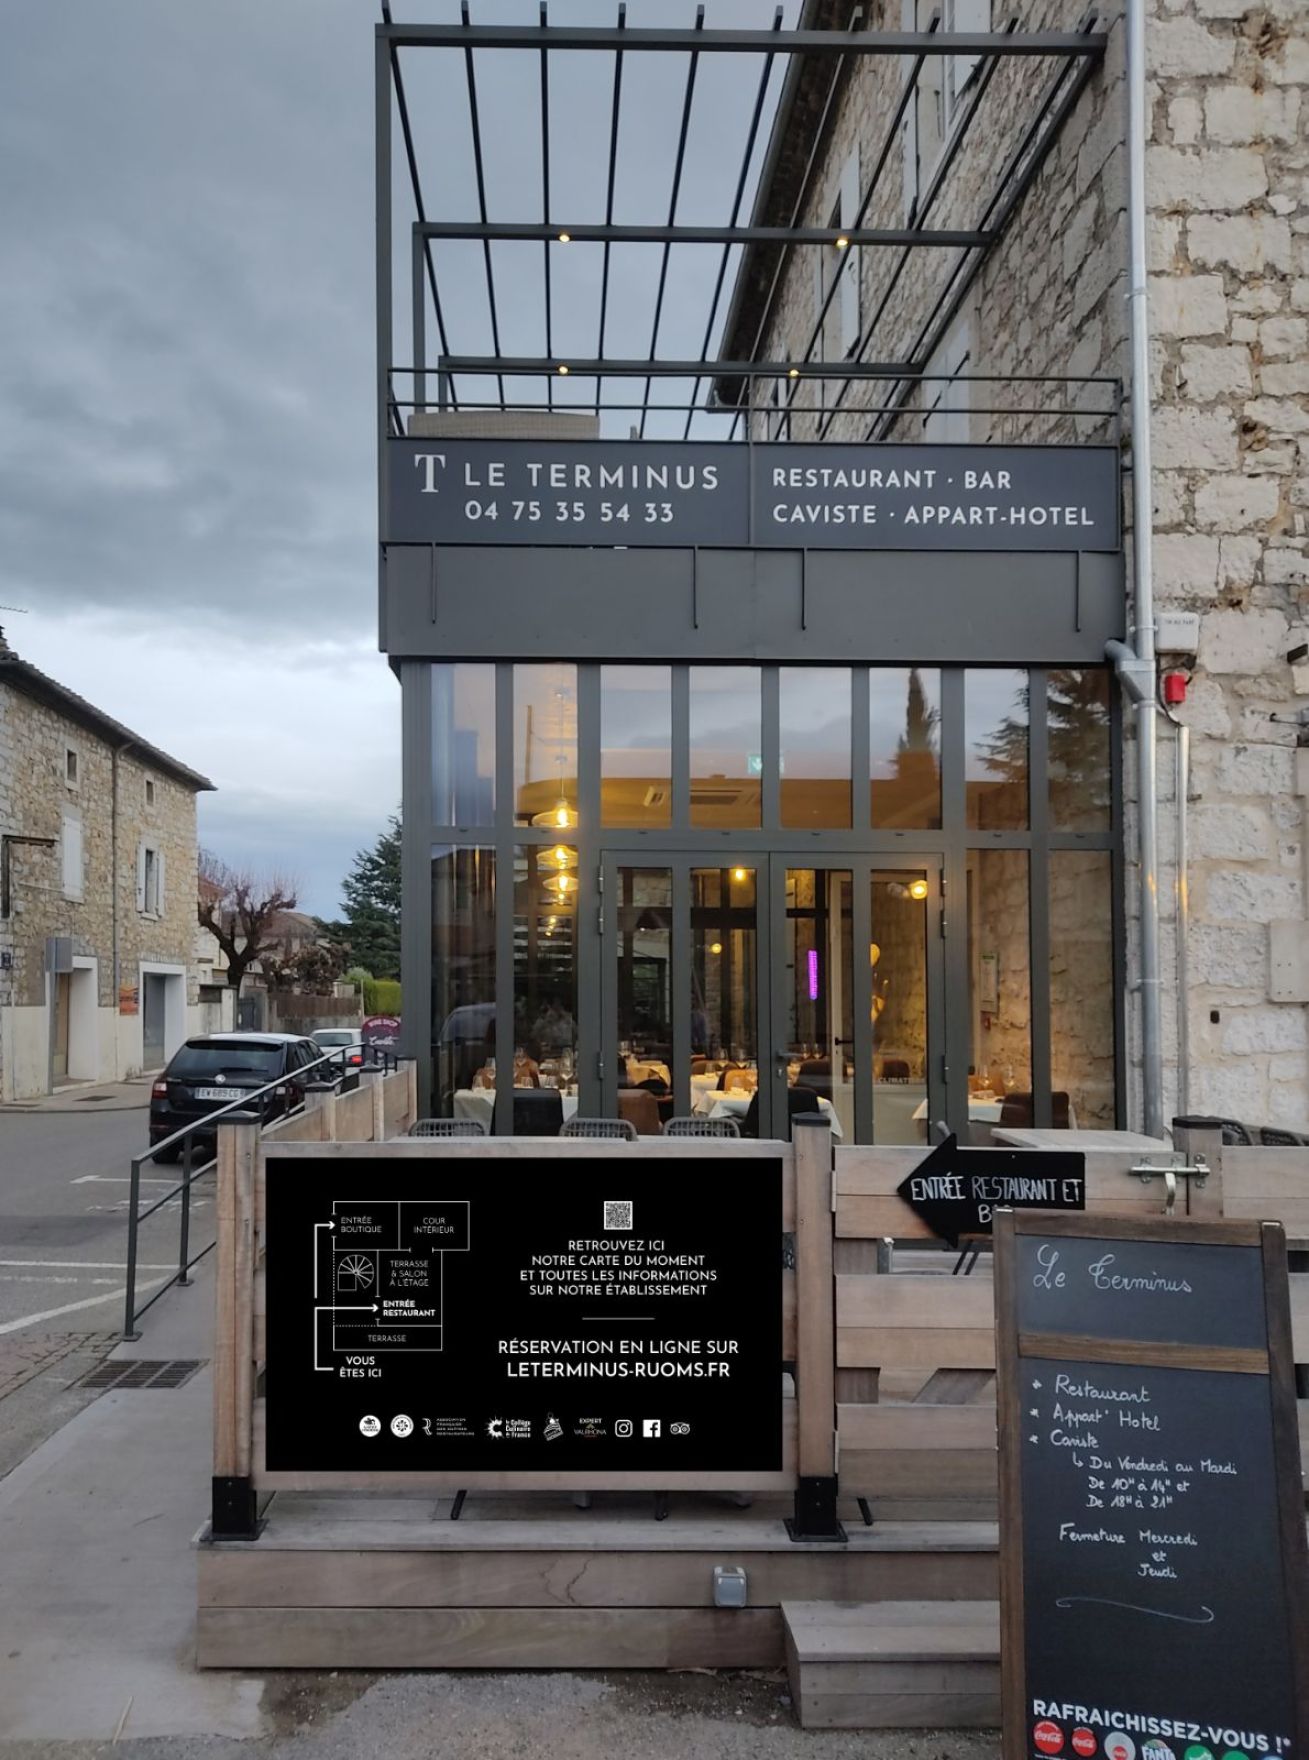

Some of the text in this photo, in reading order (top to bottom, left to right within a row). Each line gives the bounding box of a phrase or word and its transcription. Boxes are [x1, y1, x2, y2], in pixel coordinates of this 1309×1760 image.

[414, 453, 446, 493] T
[465, 462, 718, 490] LE TERMINUS
[773, 468, 1011, 489] RESTAURANT BAR
[464, 500, 674, 523] 04 75 35 54 33
[772, 503, 1094, 526] CAVISTE APPART-HOTEL
[911, 1172, 1083, 1202] ENTRÉE RESTAURANT ET
[340, 1215, 372, 1224] ENTRÉE
[422, 1217, 446, 1225] COUR
[340, 1225, 382, 1233] BOUTIQUE
[414, 1226, 454, 1234] INTÉRIEUR
[568, 1239, 665, 1251] RETROUVEZ ICI
[390, 1260, 428, 1268] TERRASSE
[531, 1255, 705, 1266] NOTRE CARTE DU MOMENT
[399, 1269, 428, 1278] SALON
[520, 1269, 717, 1281] ET TOUTES LES INFORMATIONS
[1033, 1244, 1193, 1293] Le Terminus
[529, 1282, 708, 1296] SUR NOTRE ÉTABLISSEMENT
[382, 1298, 416, 1308] ENTRÉE
[382, 1309, 436, 1317] RESTAURANT
[367, 1334, 406, 1343] TERRASSE
[498, 1337, 739, 1354] RÉSERVATION EN LIGNE SUR
[345, 1355, 376, 1366] VOUS
[339, 1366, 382, 1378] ÊTES ICI
[507, 1361, 730, 1377] LETERMINUS-RUOMS.FR
[1055, 1374, 1151, 1403] Restaurant
[1119, 1410, 1161, 1432] Hotel
[1050, 1429, 1100, 1449] Caviste
[1089, 1456, 1238, 1476] Du Vendredi au Mardi
[1088, 1476, 1106, 1491] De
[1137, 1480, 1148, 1492] à
[1176, 1482, 1191, 1493] et
[1086, 1494, 1105, 1509] De
[1134, 1497, 1145, 1509] à
[1059, 1522, 1199, 1546] Fermeture Mercredi
[1152, 1550, 1167, 1563] et
[1137, 1563, 1178, 1579] Jeudi
[1033, 1699, 1270, 1751] RAFRAICHISSEZ-VOUS
